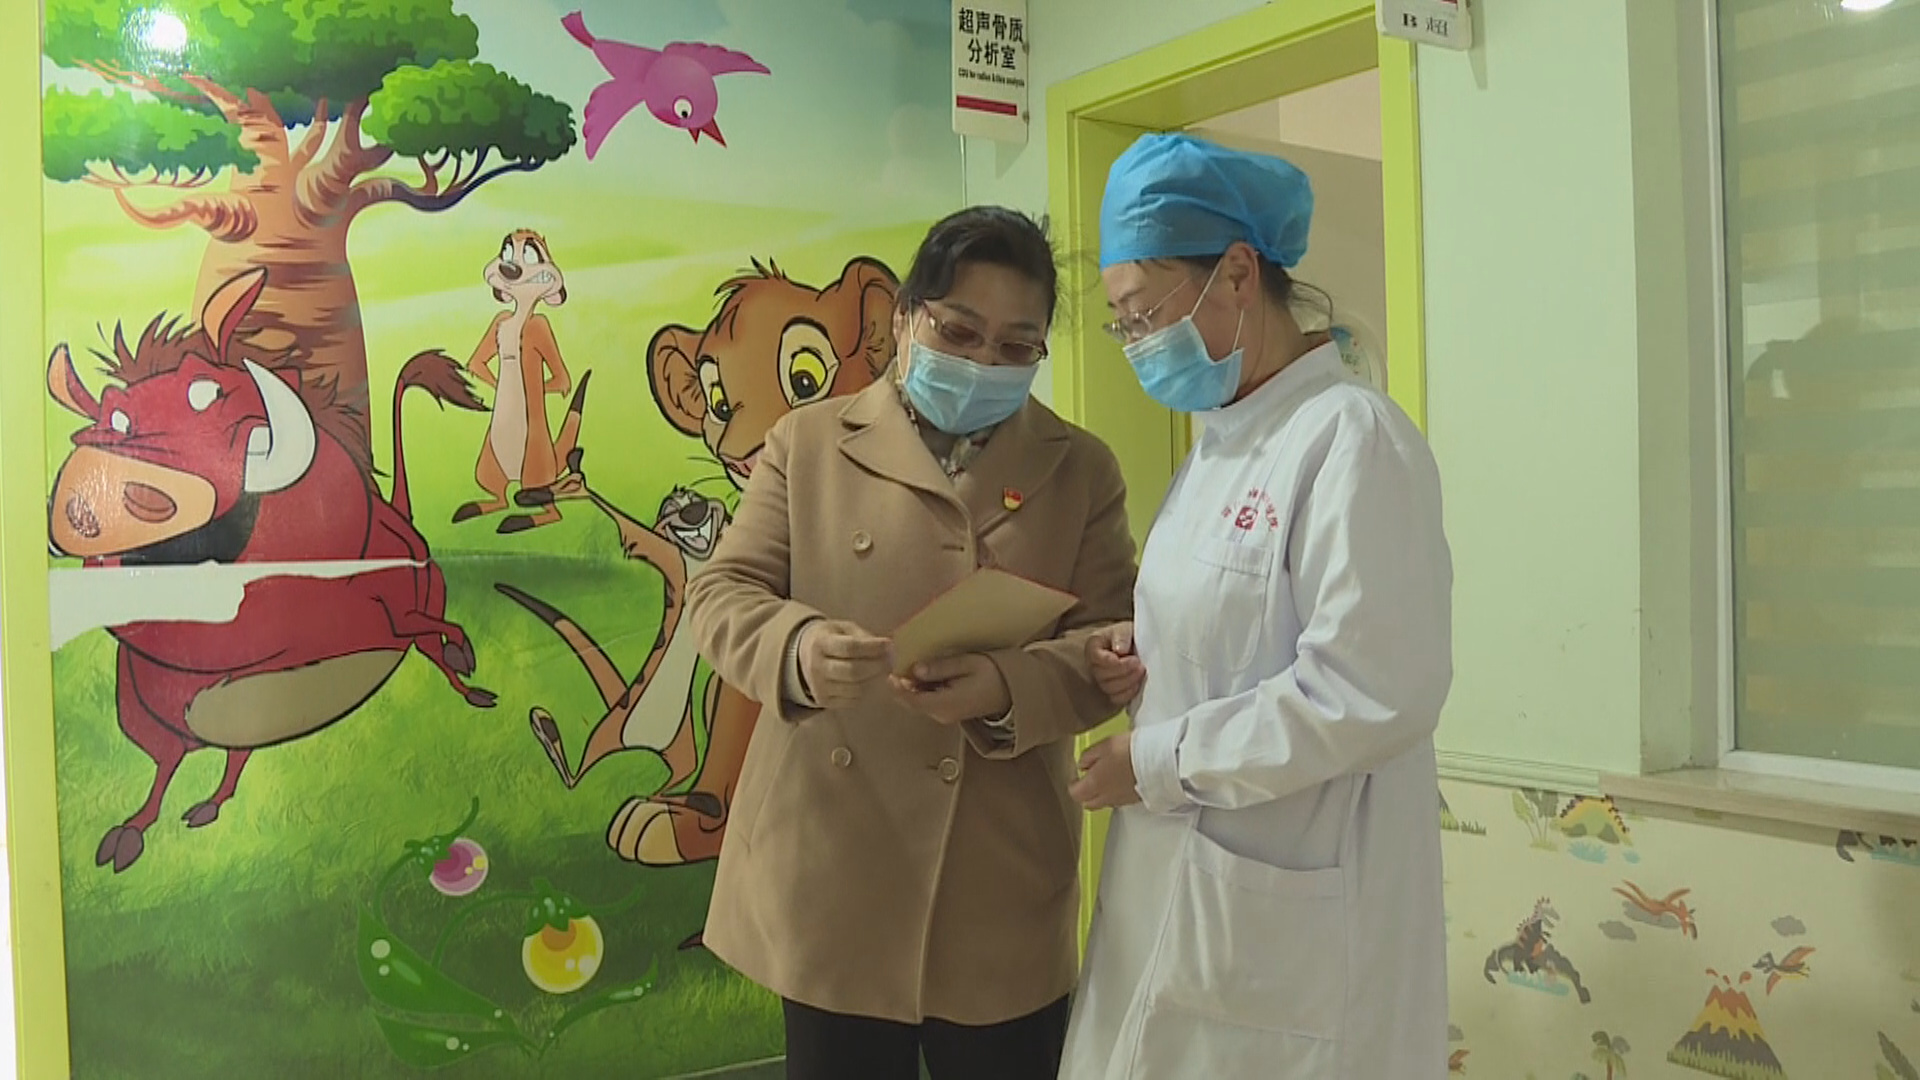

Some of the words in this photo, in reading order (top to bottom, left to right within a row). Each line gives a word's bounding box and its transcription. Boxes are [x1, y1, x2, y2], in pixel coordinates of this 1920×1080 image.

[958, 7, 1024, 43] 超声骨质
[1403, 13, 1417, 28] B
[968, 38, 1016, 70] 分析室
